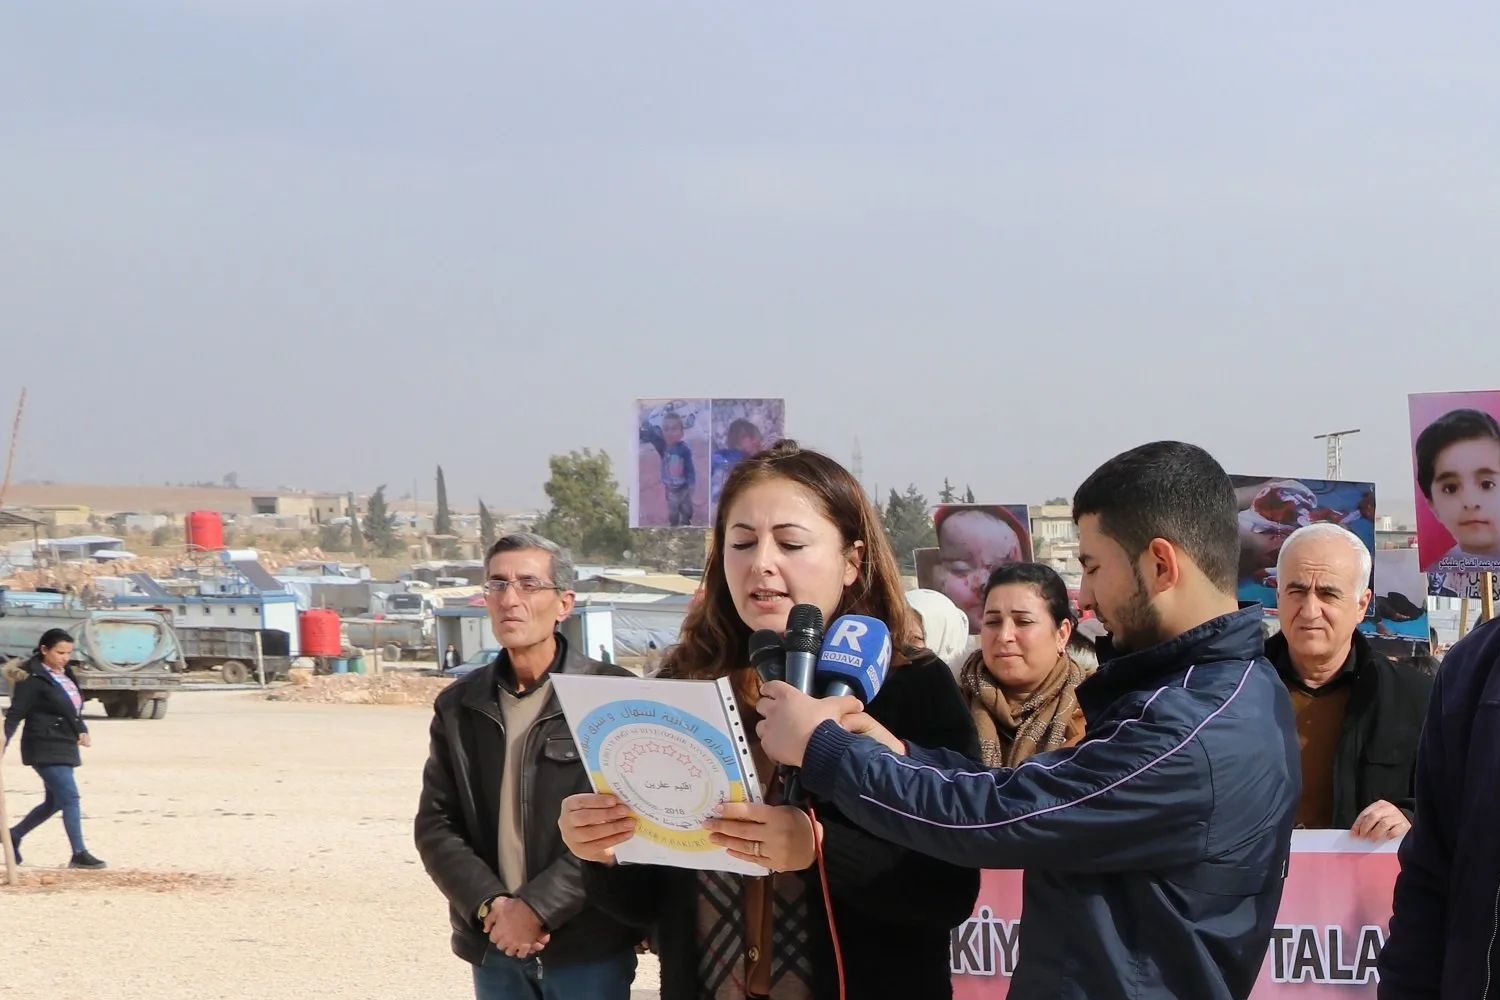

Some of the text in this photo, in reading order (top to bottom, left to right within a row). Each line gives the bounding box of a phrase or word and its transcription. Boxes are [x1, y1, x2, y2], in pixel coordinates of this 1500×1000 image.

[830, 619, 868, 652] R
[822, 651, 862, 666] ROJAVA
[664, 807, 685, 816] 2018
[1269, 928, 1382, 981] TALA
